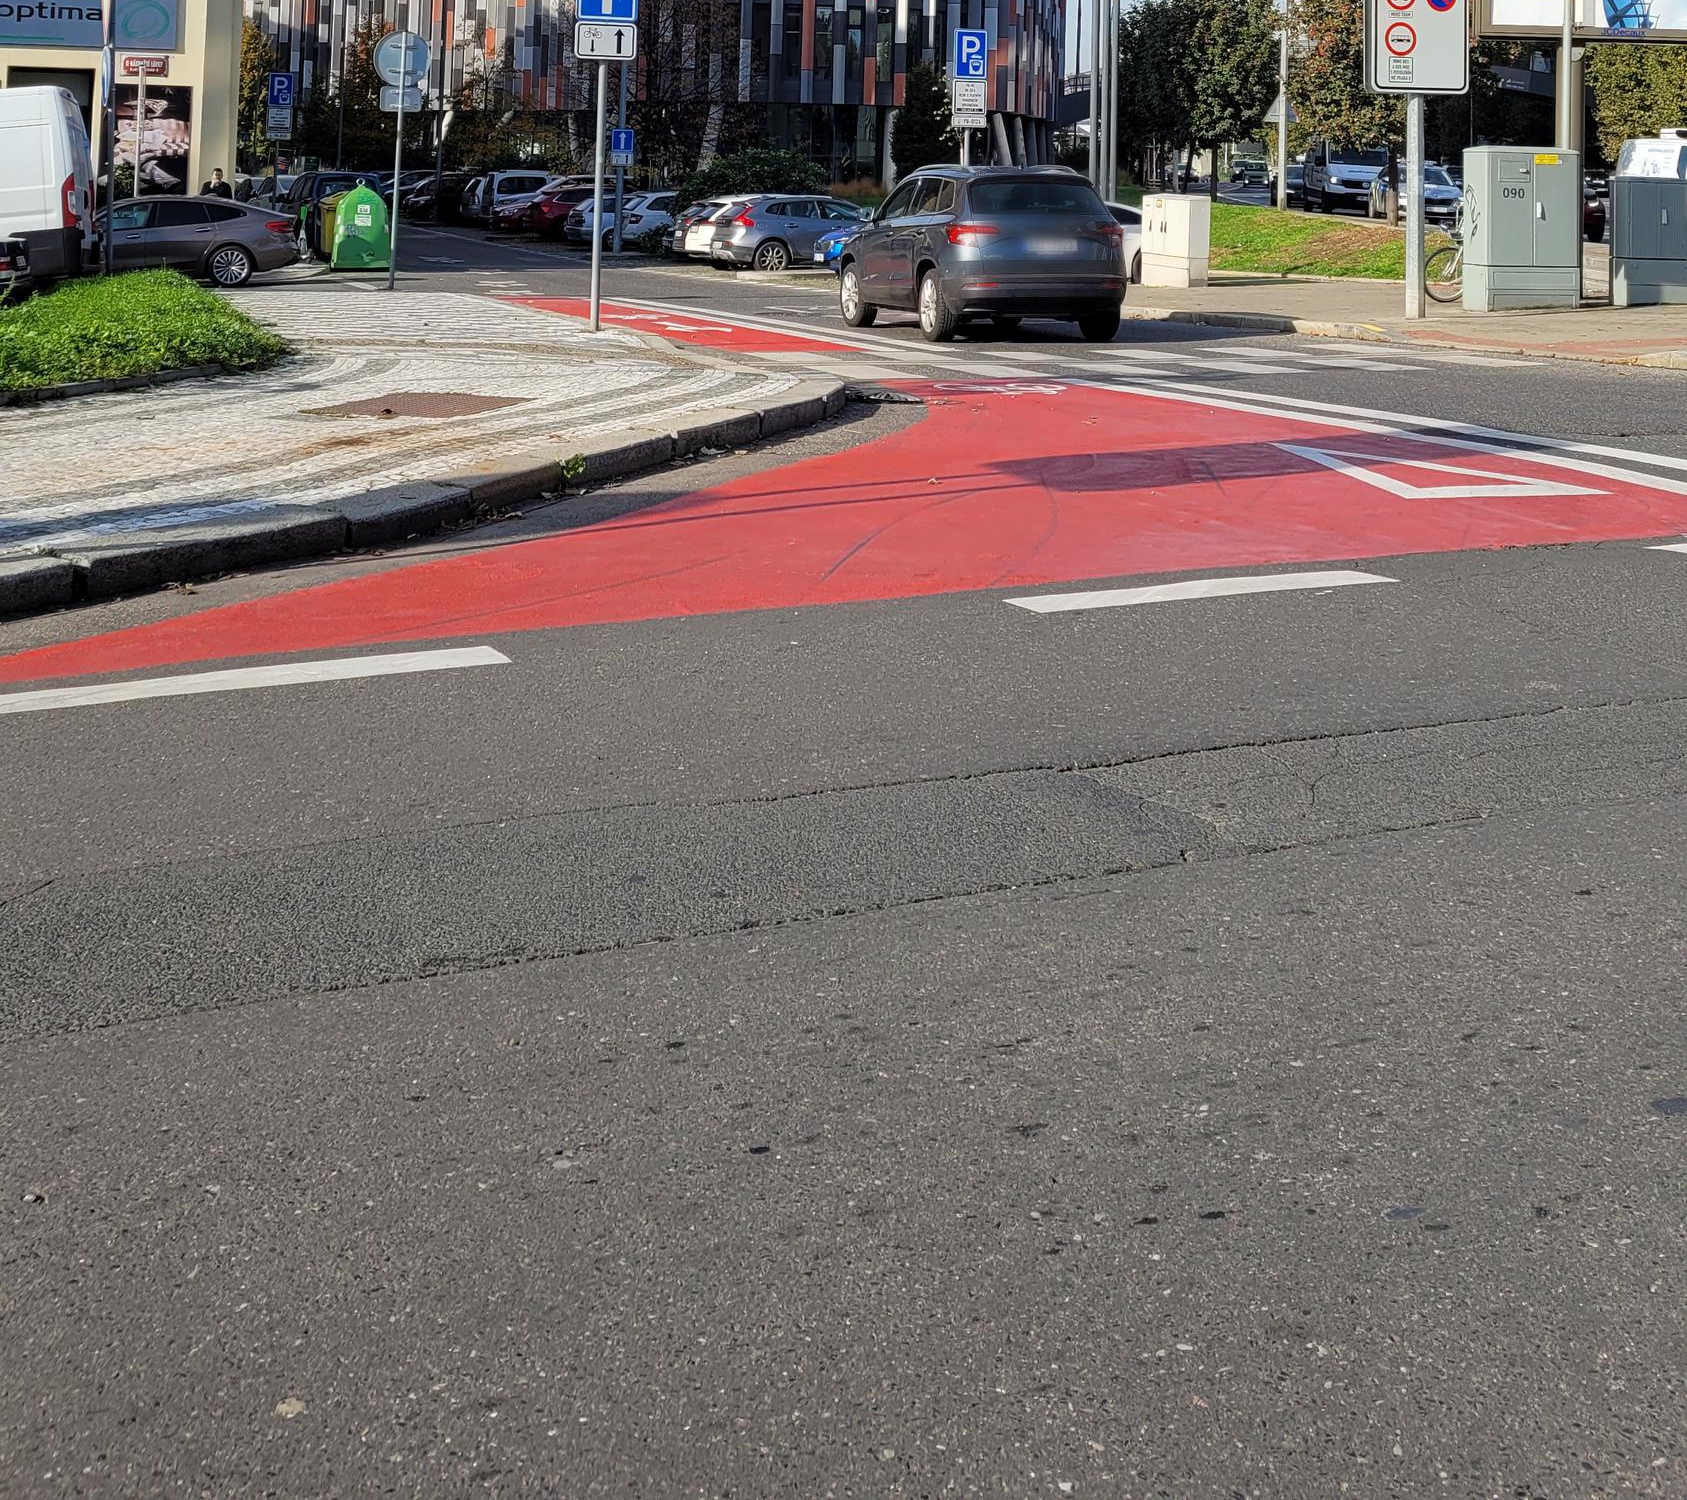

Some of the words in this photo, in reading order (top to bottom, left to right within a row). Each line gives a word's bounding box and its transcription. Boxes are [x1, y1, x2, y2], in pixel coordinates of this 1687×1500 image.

[961, 35, 981, 63] P
[273, 76, 289, 96] P
[1502, 187, 1525, 199] 090
